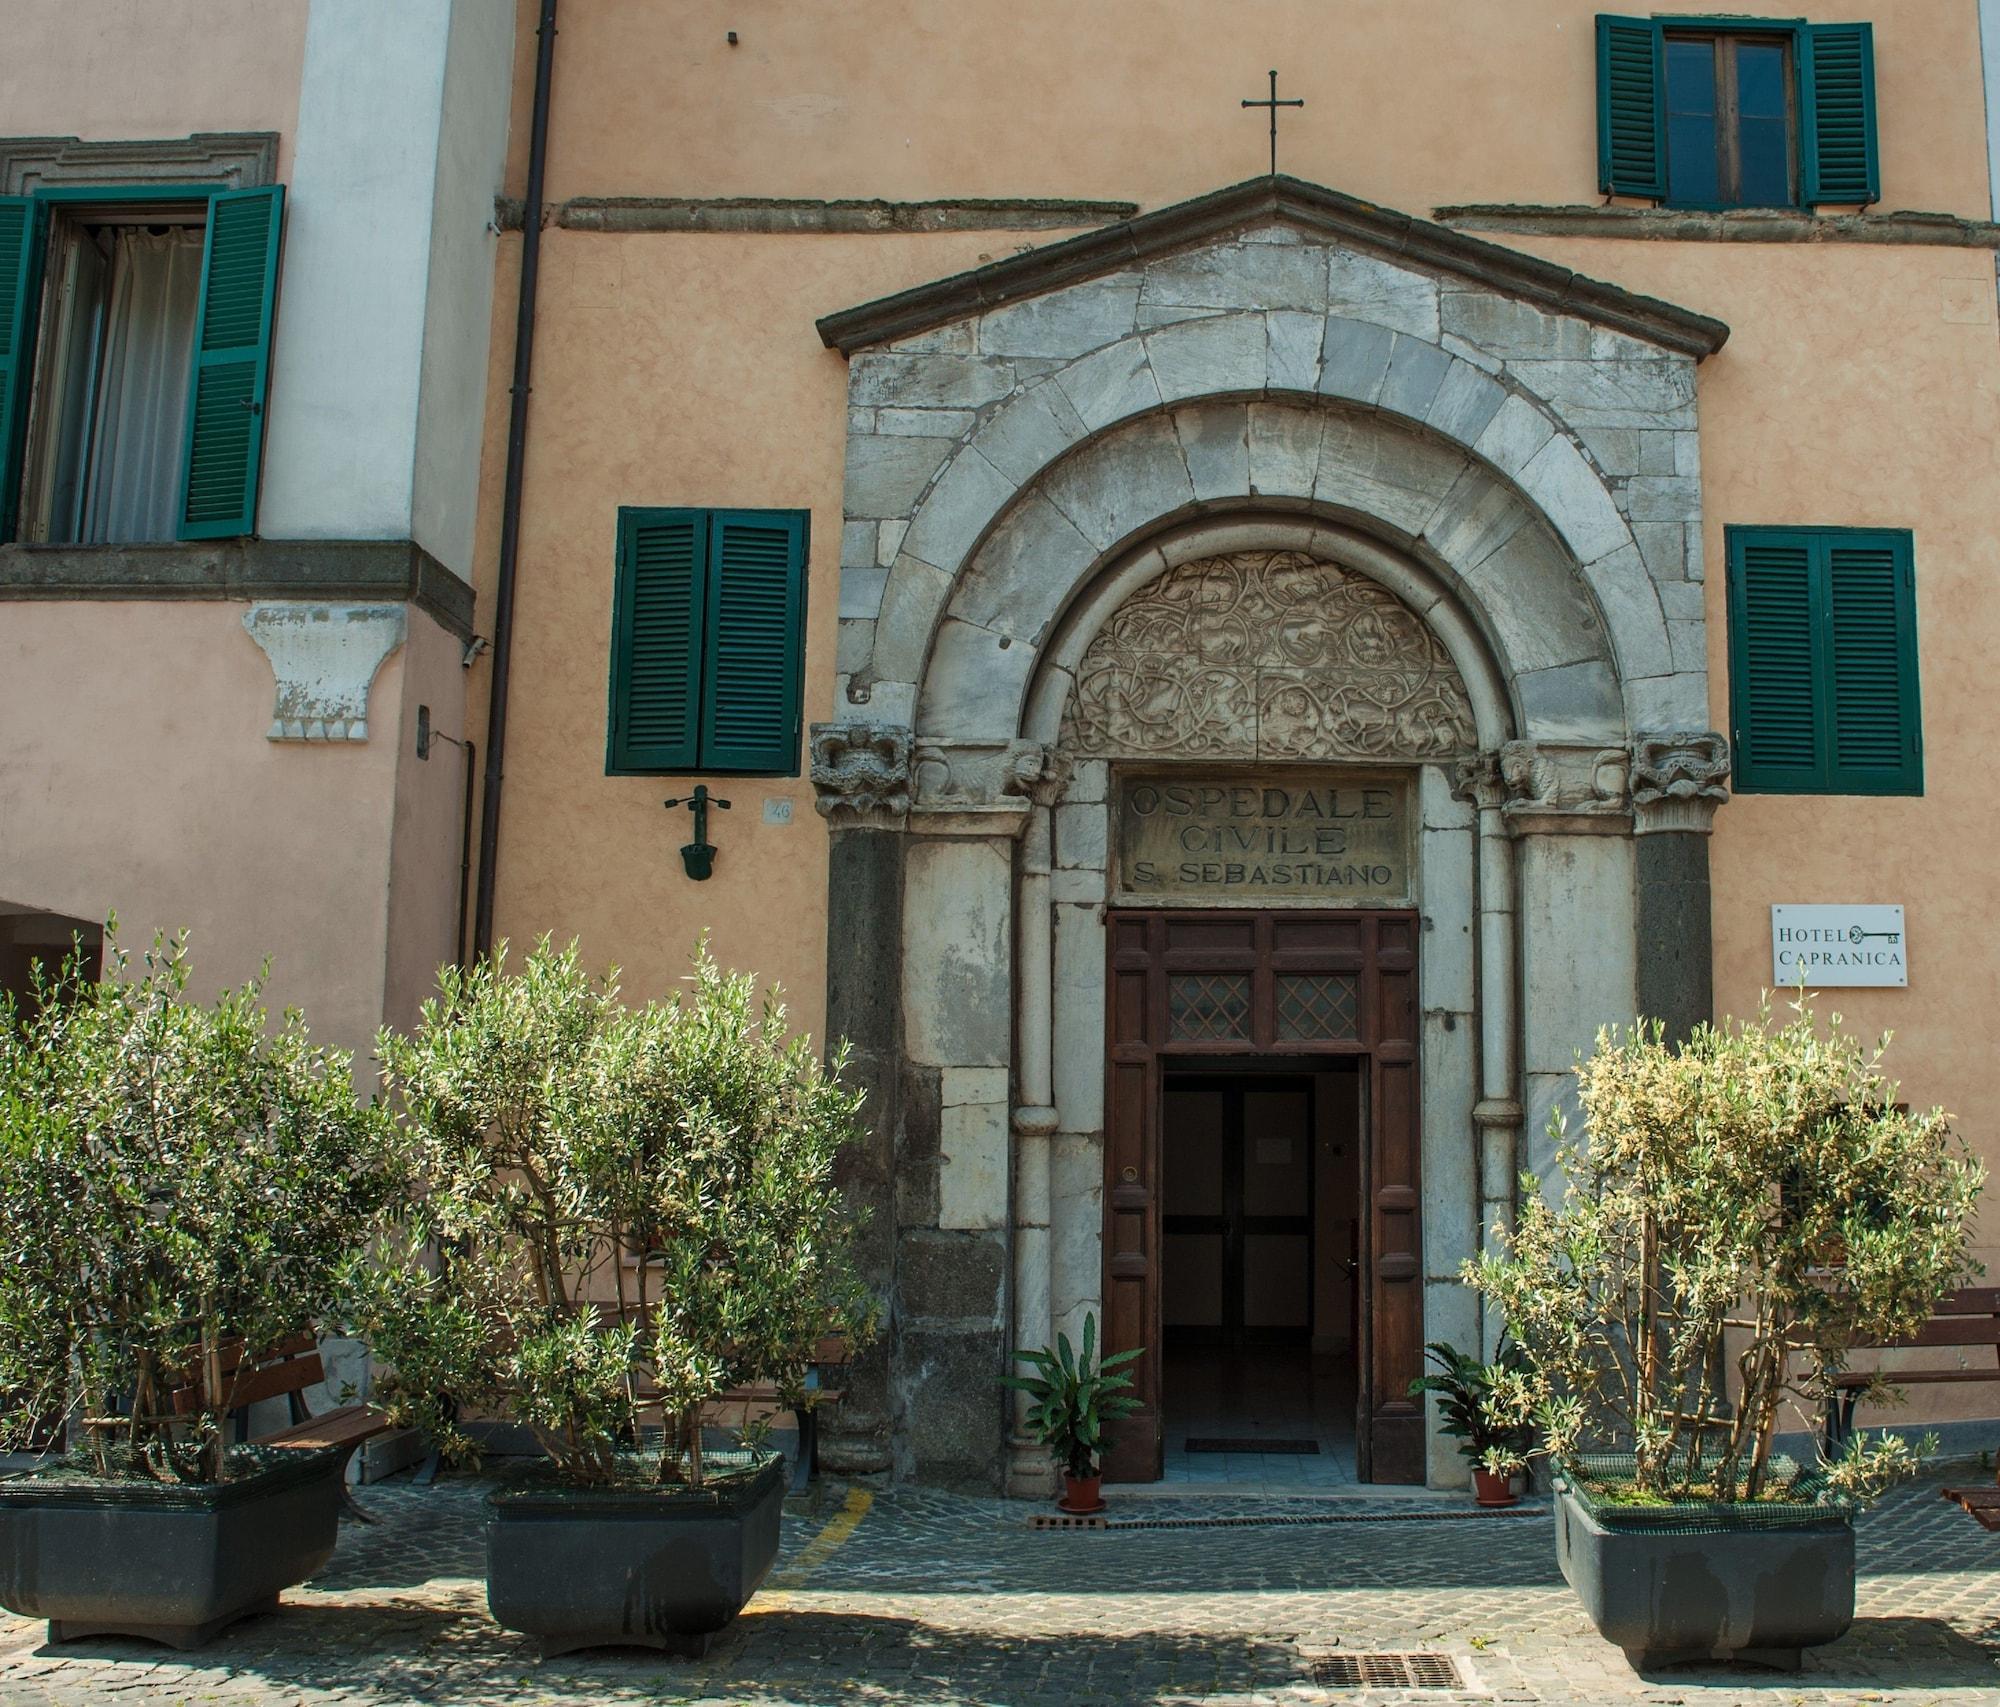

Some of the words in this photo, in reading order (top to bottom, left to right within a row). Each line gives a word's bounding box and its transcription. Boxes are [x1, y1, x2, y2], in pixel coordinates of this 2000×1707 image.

[1130, 785, 1393, 819] OSPEDALE
[1179, 825, 1347, 855] CIVILE
[1179, 863, 1393, 886] SEBASTIANO
[1778, 927, 1848, 943] HOTEL
[1779, 950, 1901, 966] CAPRANICA
